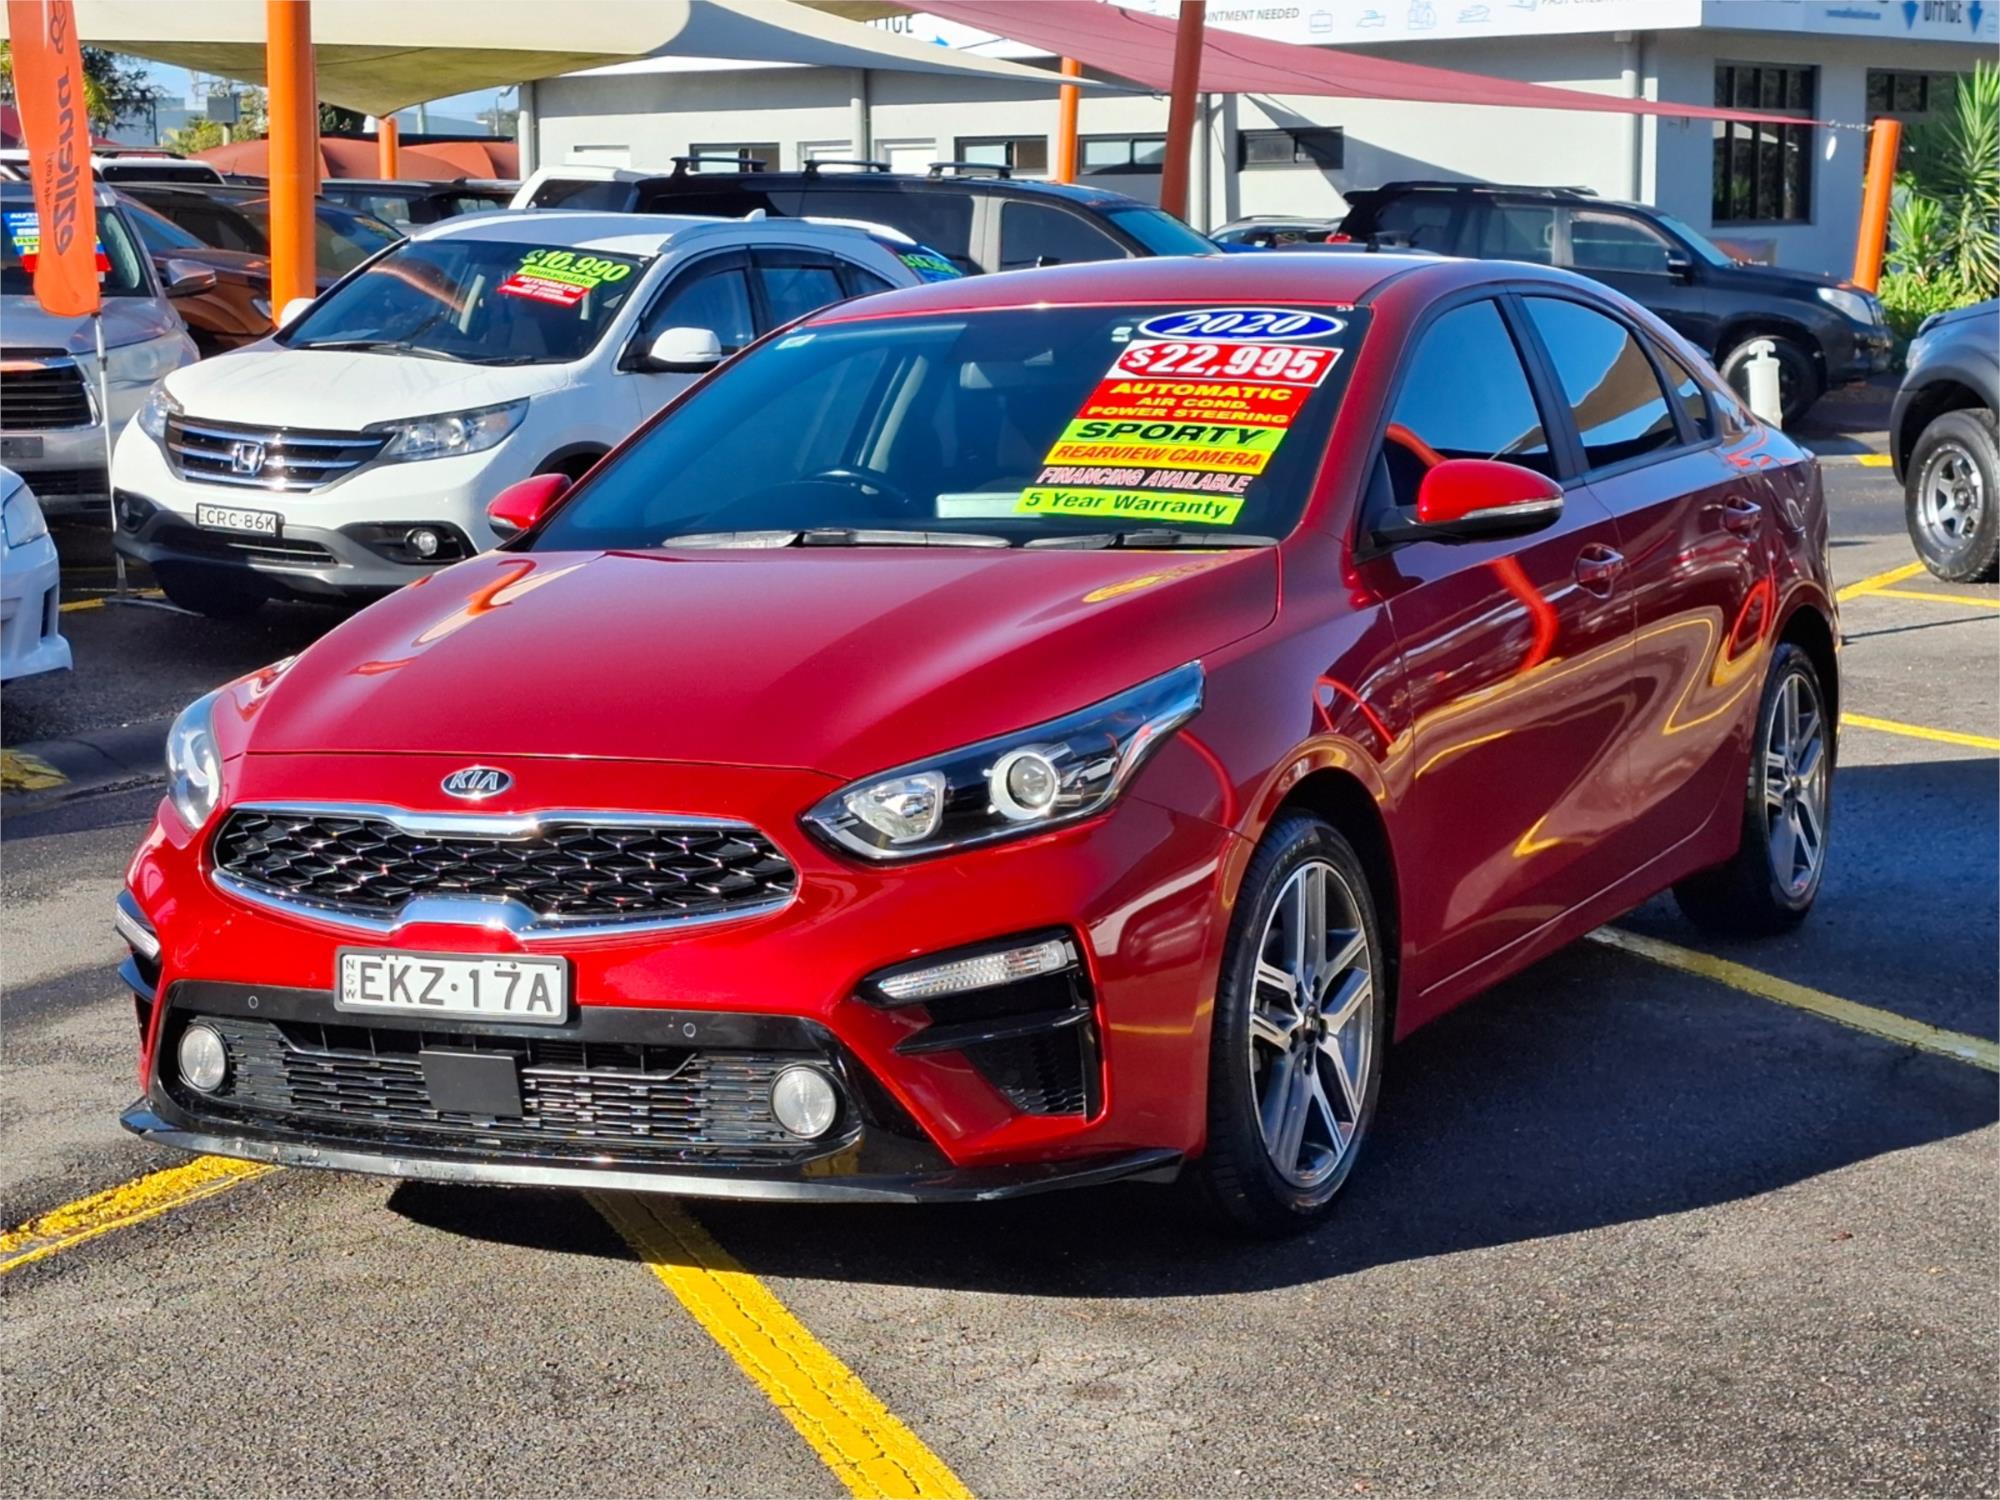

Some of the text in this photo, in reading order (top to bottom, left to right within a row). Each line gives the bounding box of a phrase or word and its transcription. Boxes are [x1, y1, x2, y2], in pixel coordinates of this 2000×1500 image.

[1256, 7, 1300, 20] NEEDED
[1163, 313, 1312, 335] 2020
[1126, 343, 1326, 380] $22,995
[1109, 383, 1293, 401] AUTOMATIC
[1136, 397, 1251, 410] AIR COND.
[1086, 406, 1289, 425] POWER STEERING
[1076, 422, 1265, 445] SPORTY
[1053, 445, 1263, 469] REARVIEW CAMERA
[1035, 467, 1253, 494] FINANCING AVAILABLE
[1025, 492, 1230, 520] 5 Year Warranty
[448, 770, 499, 790] KIA
